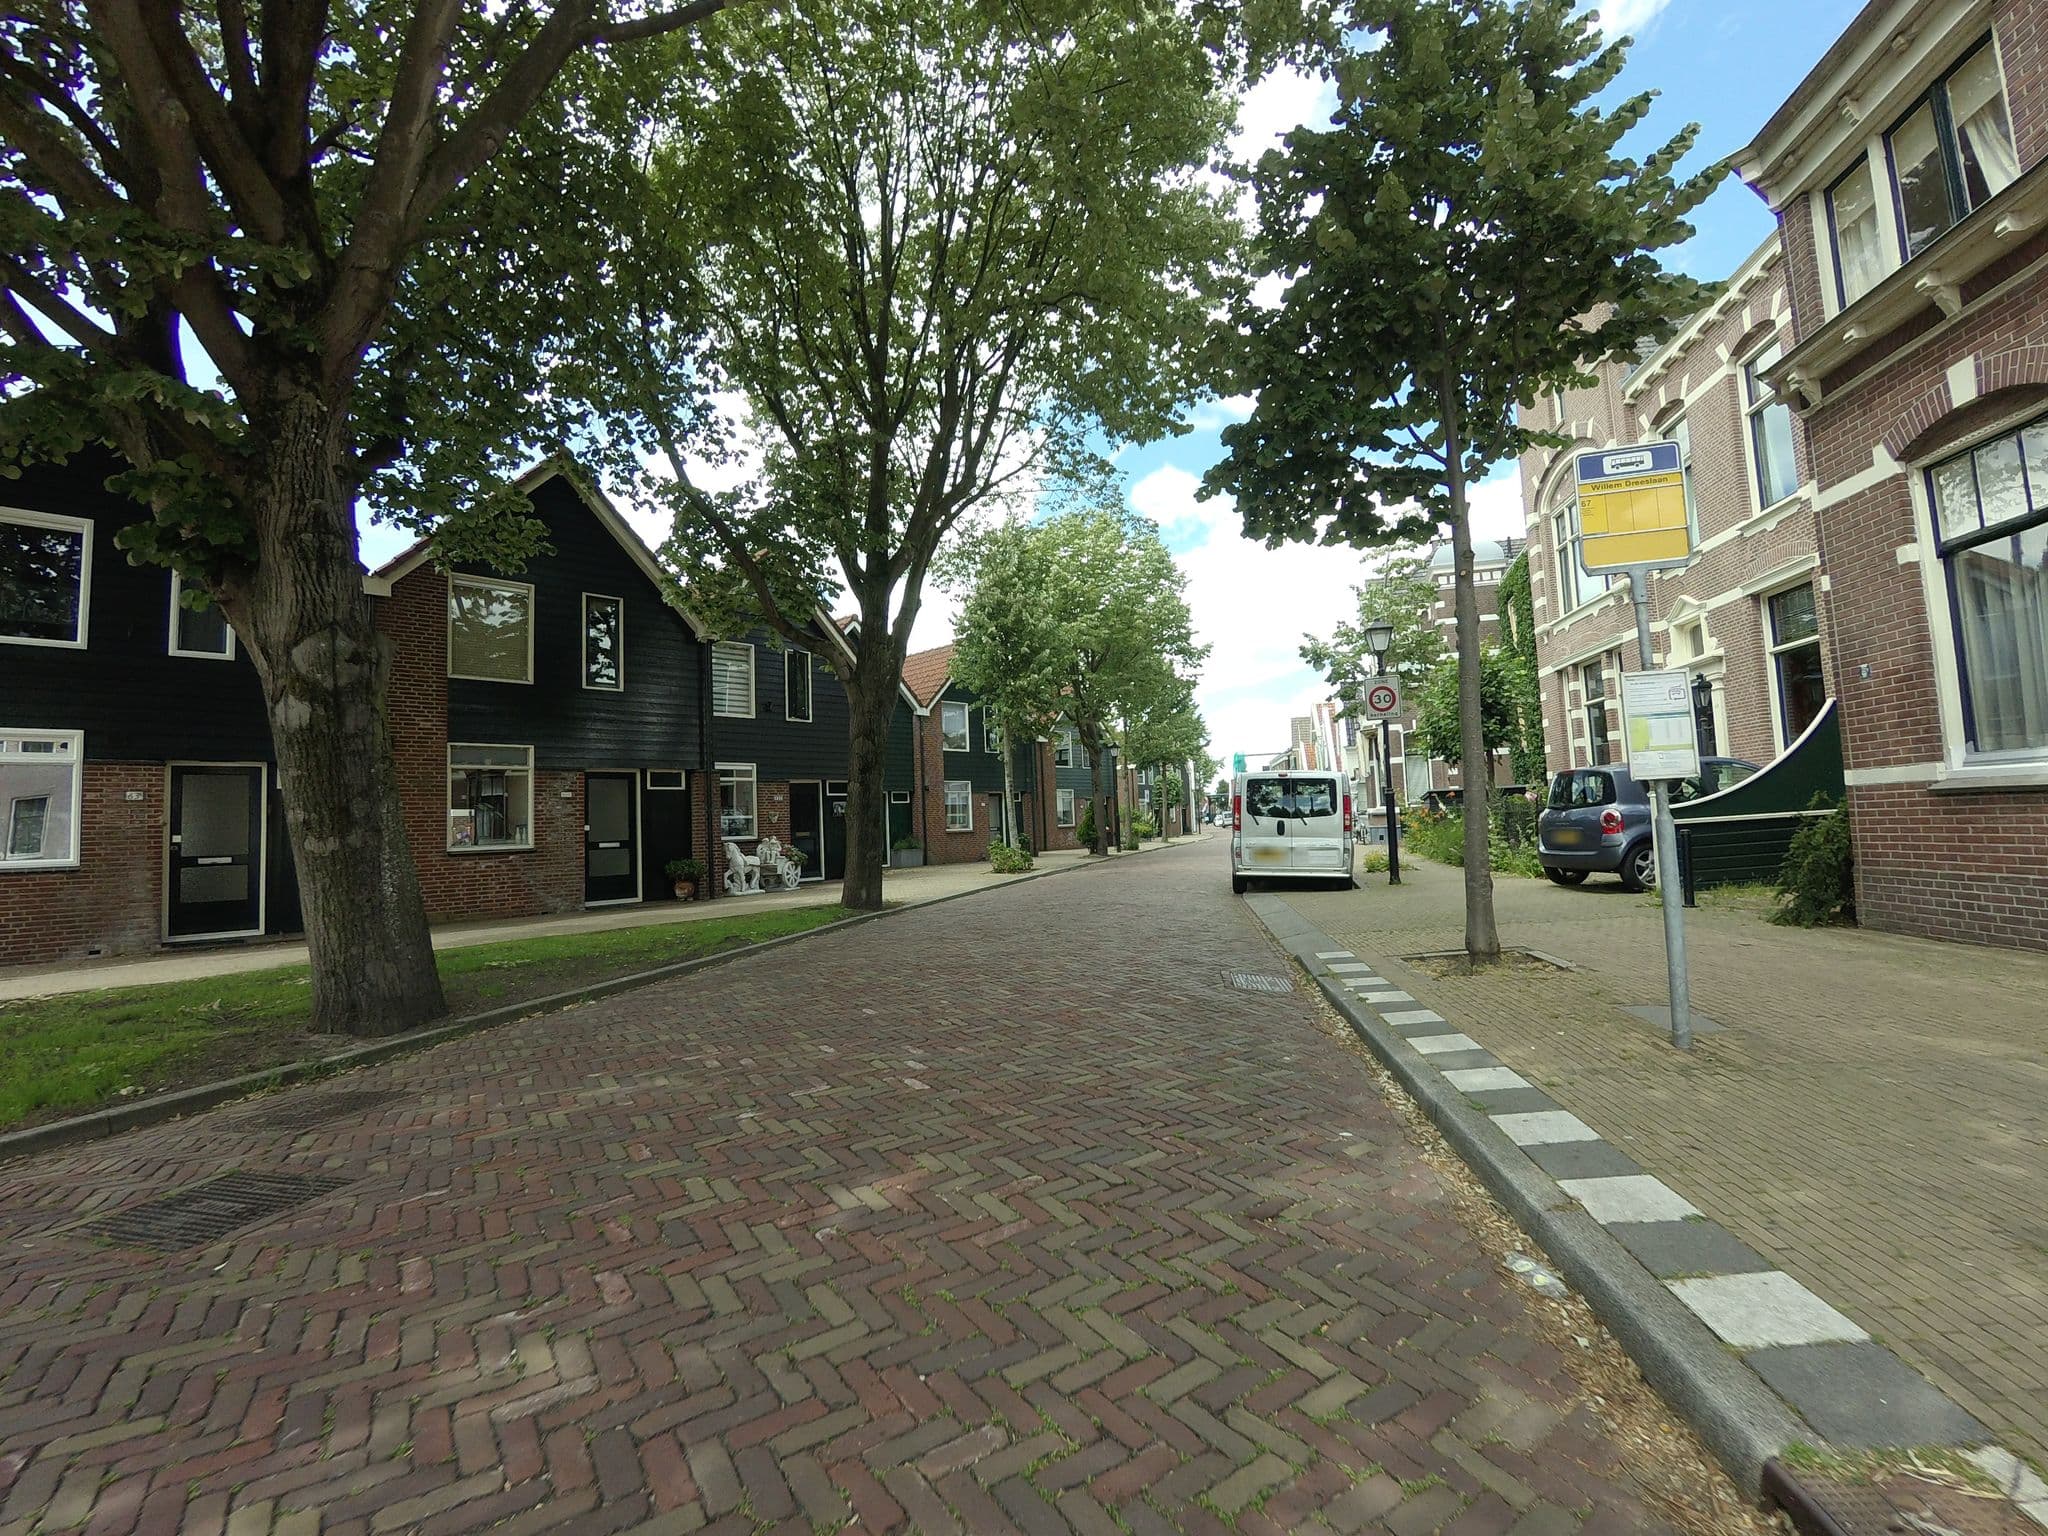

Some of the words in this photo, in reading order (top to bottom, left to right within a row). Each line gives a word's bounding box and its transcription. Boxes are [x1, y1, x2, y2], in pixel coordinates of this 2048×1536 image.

[1590, 482, 1623, 492] Willem
[1625, 476, 1669, 487] Dreeslaan
[1374, 693, 1392, 704] 30
